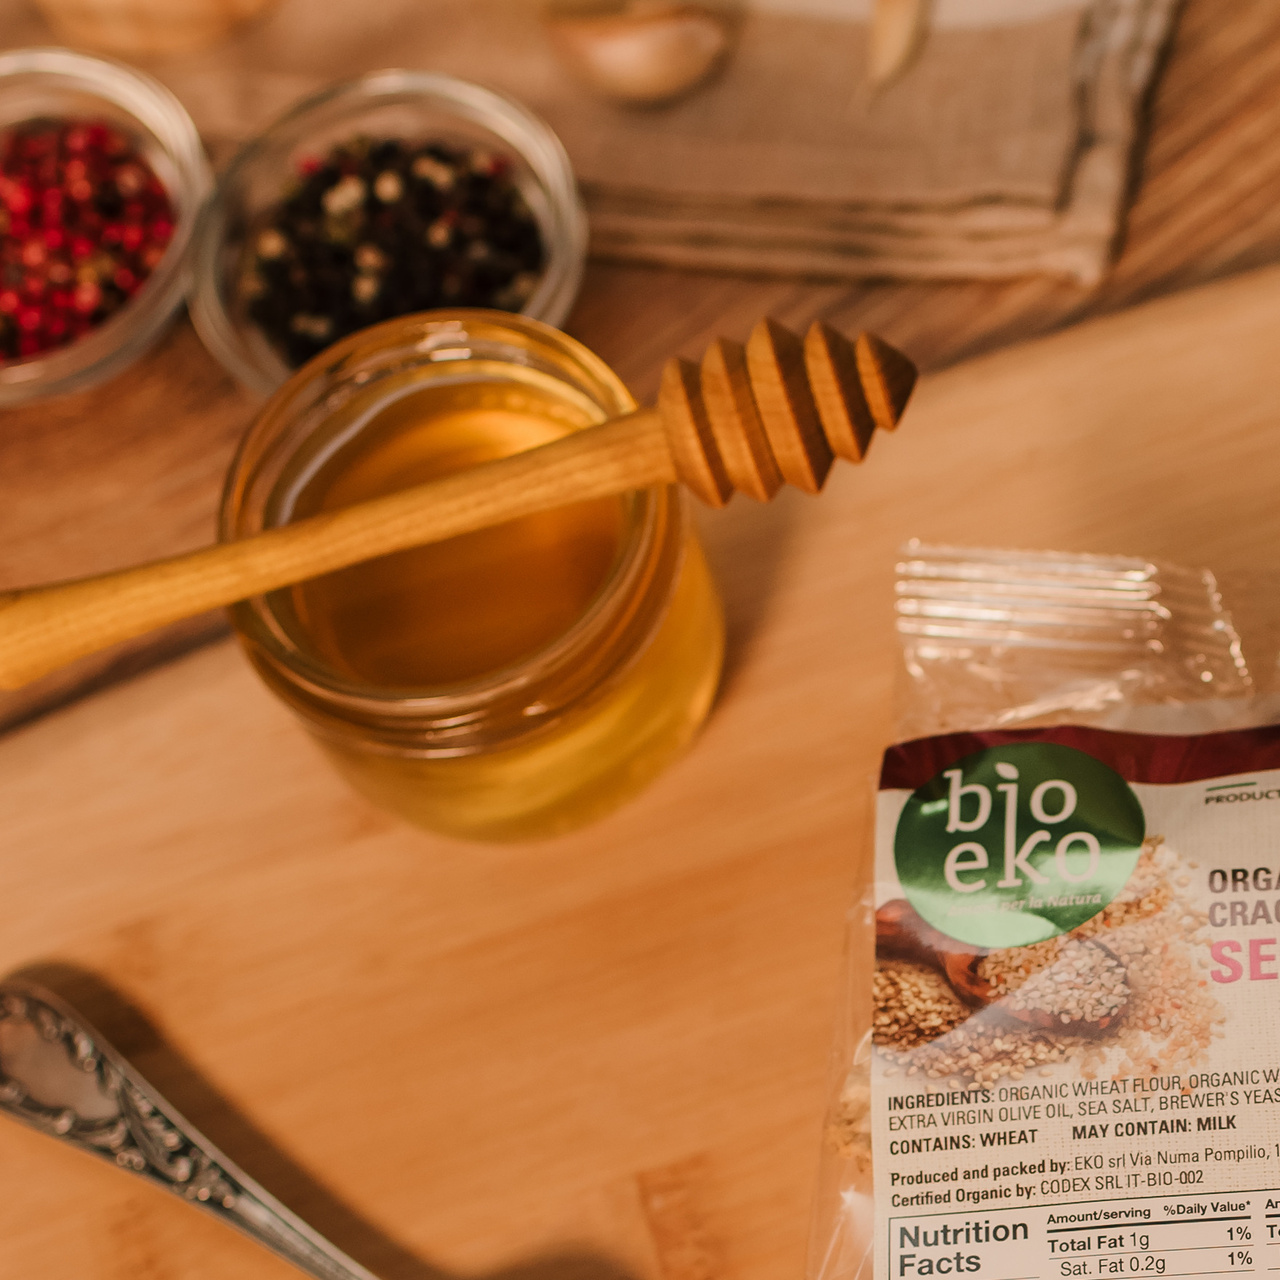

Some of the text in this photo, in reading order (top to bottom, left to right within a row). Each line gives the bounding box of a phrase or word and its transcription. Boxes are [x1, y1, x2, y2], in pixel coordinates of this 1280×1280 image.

[943, 762, 1078, 833] bio
[943, 830, 1101, 893] eko
[1046, 893, 1101, 907] Natura
[888, 1089, 995, 1111] INGREDIENTS:
[999, 1083, 1069, 1101] ORGANIC
[1072, 1079, 1129, 1096] WHEAT
[1132, 1076, 1185, 1093] FLOUR,
[1189, 1070, 1260, 1088] ORGANIC
[889, 1112, 937, 1131] EXTRA
[941, 1108, 994, 1126] VIRGIN
[999, 1104, 1041, 1122] OLIVE
[1046, 1102, 1074, 1119] OIL,
[1078, 1100, 1108, 1116] SEA
[1112, 1098, 1154, 1114] SALT,
[1159, 1091, 1239, 1111] BREWER'S
[890, 1115, 1236, 1154] CONTAINS: WHEAT MAY CONTAIN: MILK
[891, 1169, 959, 1186] Produced
[963, 1166, 989, 1181] and
[992, 1160, 1046, 1181] packed
[1050, 1158, 1071, 1174] by:
[1074, 1156, 1104, 1170] EKO
[1108, 1153, 1126, 1168] srl
[1129, 1152, 1152, 1167] Via
[1158, 1150, 1199, 1164] Numa
[1204, 1144, 1270, 1162] Pompilio,
[892, 1170, 1204, 1208] Certified Organic by: CODEX SRL IT-BIO-002
[1047, 1208, 1151, 1225] Amount/serving
[1163, 1204, 1207, 1219] %Daily
[899, 1221, 1029, 1249] Nutrition
[1048, 1226, 1252, 1253] Total Fat 1g 1%
[899, 1251, 982, 1277] Facts
[1060, 1251, 1253, 1277] Sat. Fat 0.2g 1%
